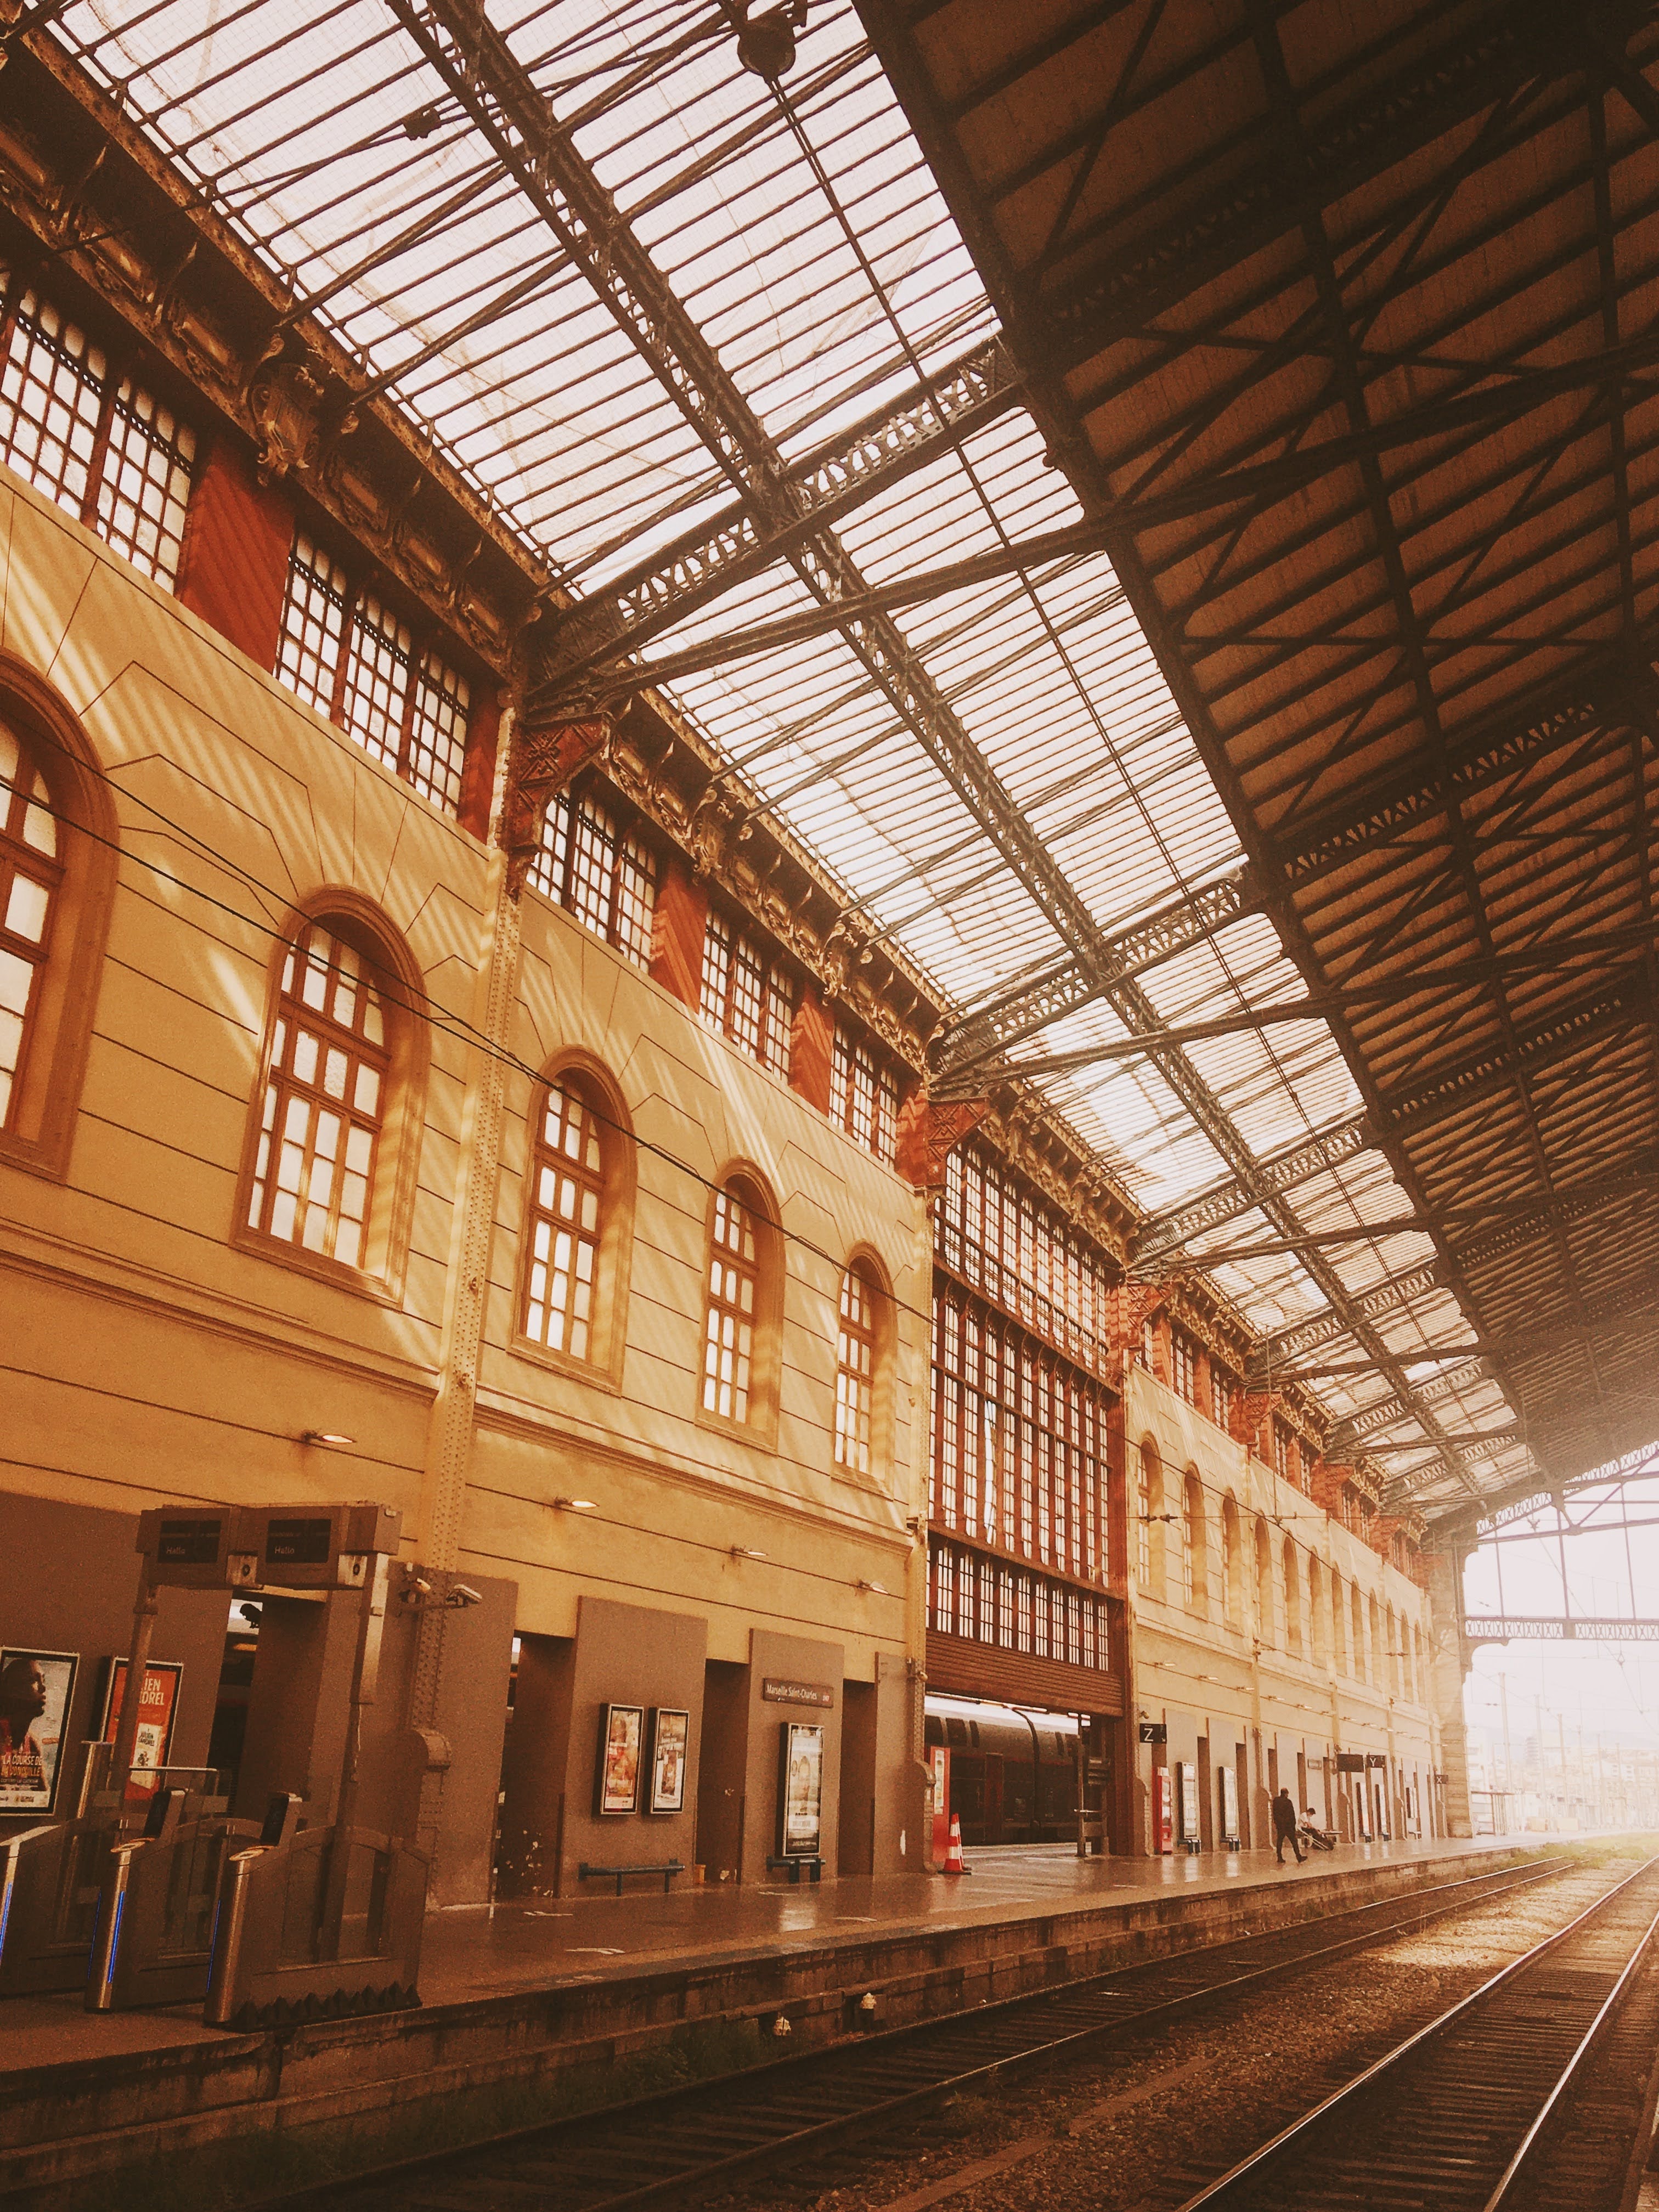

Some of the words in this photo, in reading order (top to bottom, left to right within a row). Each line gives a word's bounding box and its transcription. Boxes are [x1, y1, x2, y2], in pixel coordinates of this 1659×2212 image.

[144, 1677, 161, 1691] IEN
[766, 1683, 788, 1696] Marseille
[788, 1686, 817, 1700] Saint-Charles
[1144, 1728, 1154, 1742] Z
[12, 1755, 35, 1765] COURSE
[35, 1756, 43, 1765] DE
[1369, 1758, 1376, 1767] Y
